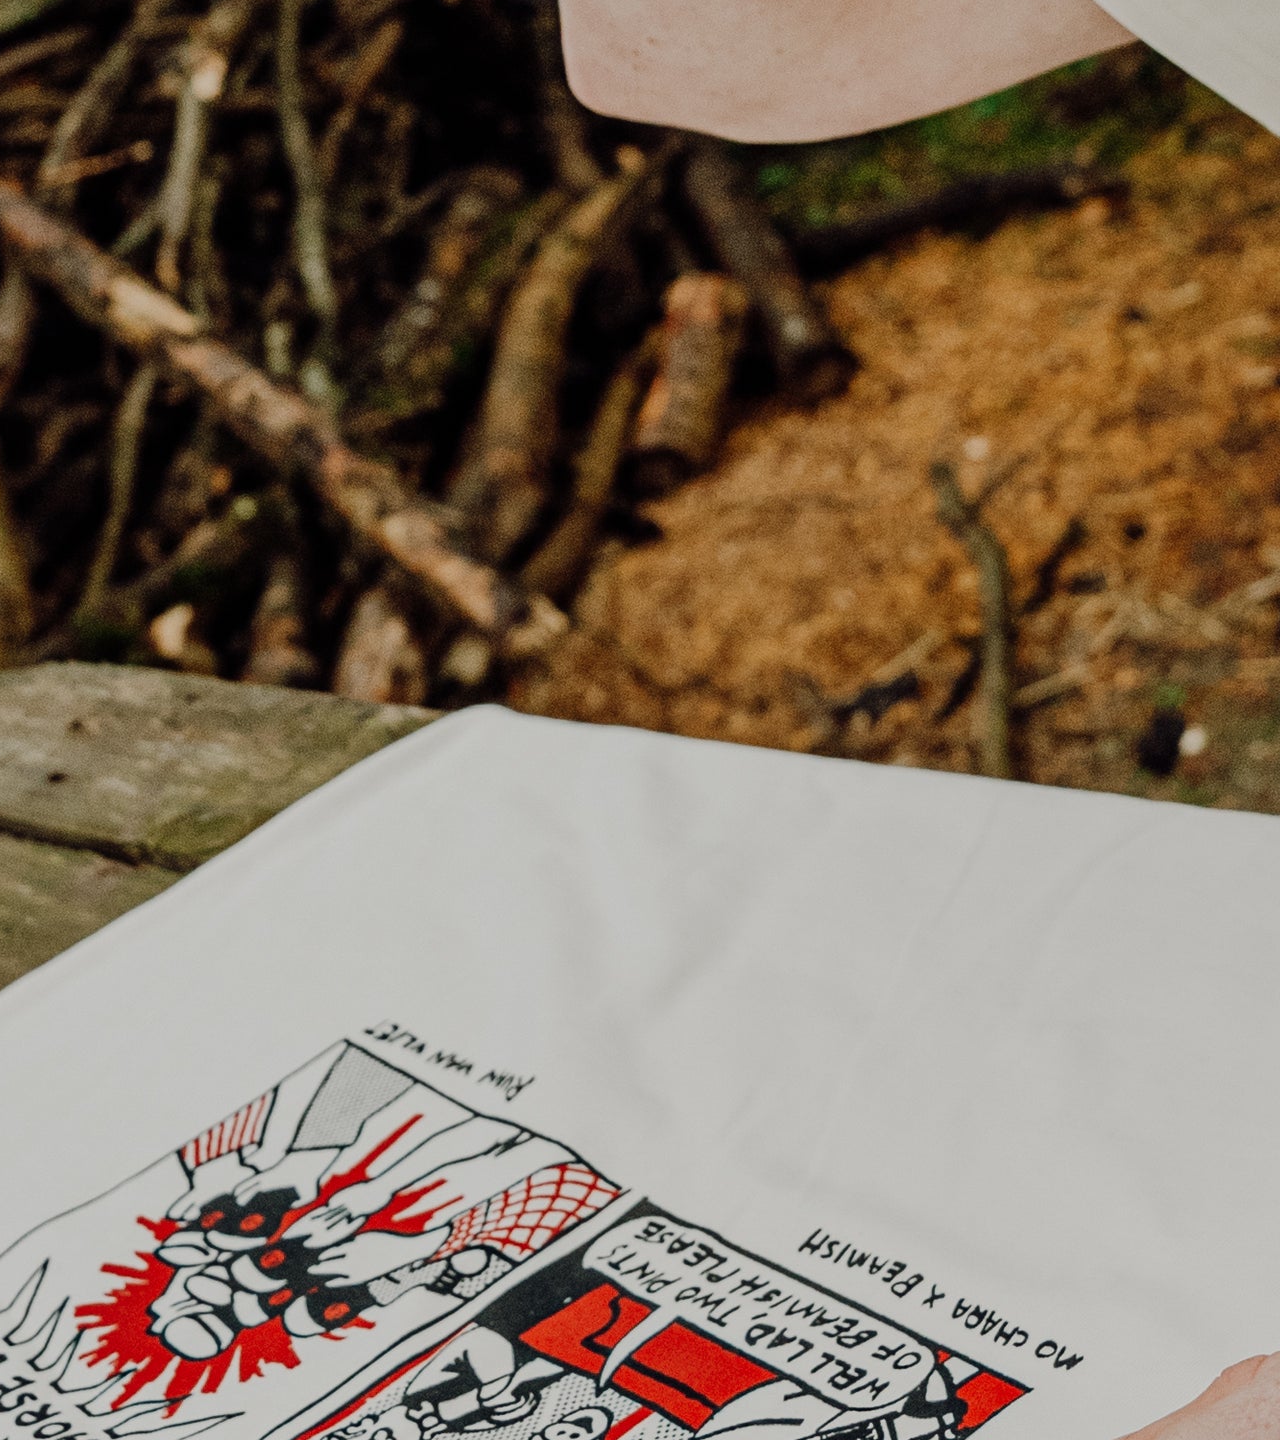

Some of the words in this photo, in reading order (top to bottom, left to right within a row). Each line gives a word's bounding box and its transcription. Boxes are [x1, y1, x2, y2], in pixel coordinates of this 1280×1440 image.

[598, 1244, 681, 1294] PINTS
[634, 1221, 740, 1284] PLEASE
[798, 1227, 924, 1298] BEAMISH
[674, 1286, 740, 1327] TWO
[729, 1275, 878, 1348] BEAMISH
[951, 1297, 1029, 1348] CHARA
[744, 1312, 814, 1363] LAD,
[871, 1343, 922, 1370] OF
[1034, 1339, 1084, 1371] MO
[811, 1352, 890, 1401] WELL
